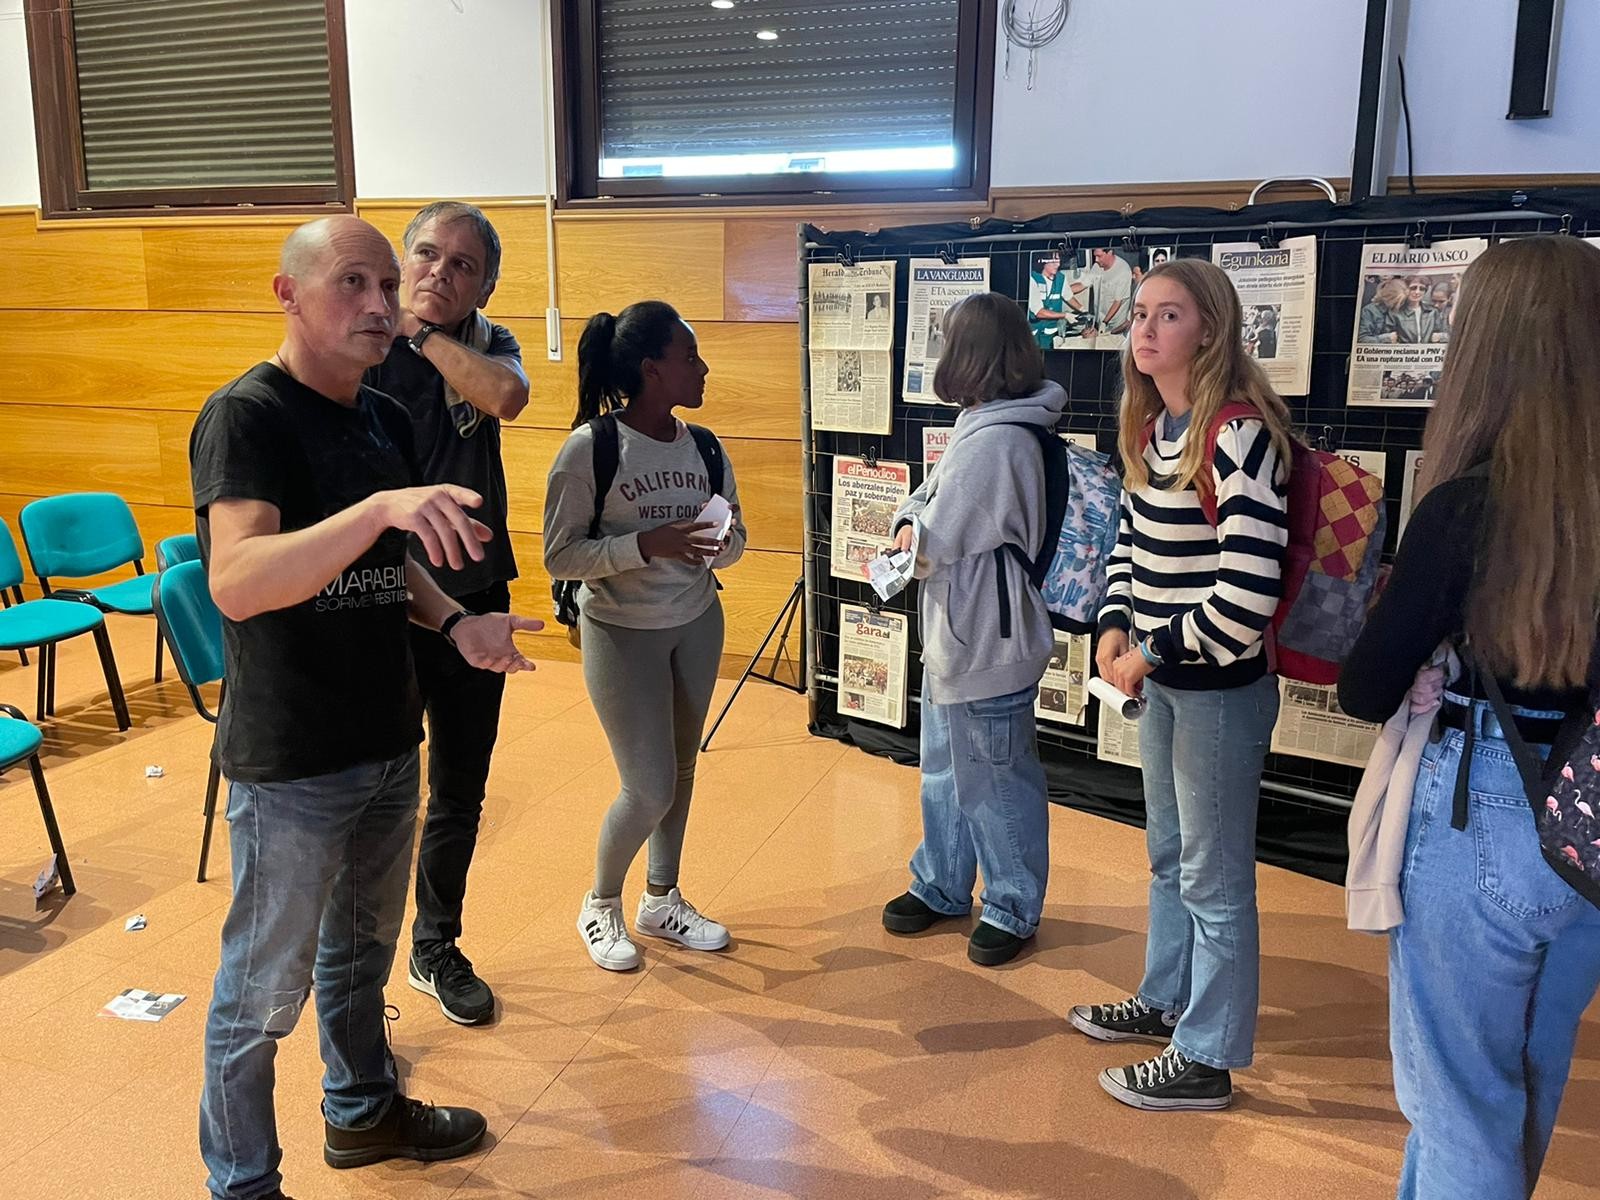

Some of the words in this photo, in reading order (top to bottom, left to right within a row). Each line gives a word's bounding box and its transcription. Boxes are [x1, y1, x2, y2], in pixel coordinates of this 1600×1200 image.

[1221, 252, 1288, 271] Egunkaria
[1372, 252, 1387, 263] EL
[1388, 252, 1430, 264] DIARIO
[1433, 249, 1468, 262] VASCO
[917, 270, 929, 280] LA
[929, 270, 983, 280] VANGUARDIA
[931, 286, 946, 296] ETA
[1363, 347, 1392, 355] Gobierno
[1393, 347, 1419, 355] reclama
[1379, 355, 1403, 363] ruptura
[620, 471, 710, 502] CALIFORN
[838, 478, 850, 487] Los
[852, 480, 885, 492] aberzales
[885, 485, 905, 496] piden
[845, 489, 857, 497] paz
[639, 505, 672, 519] WEST
[676, 504, 703, 519] COA
[856, 623, 882, 637] gara
